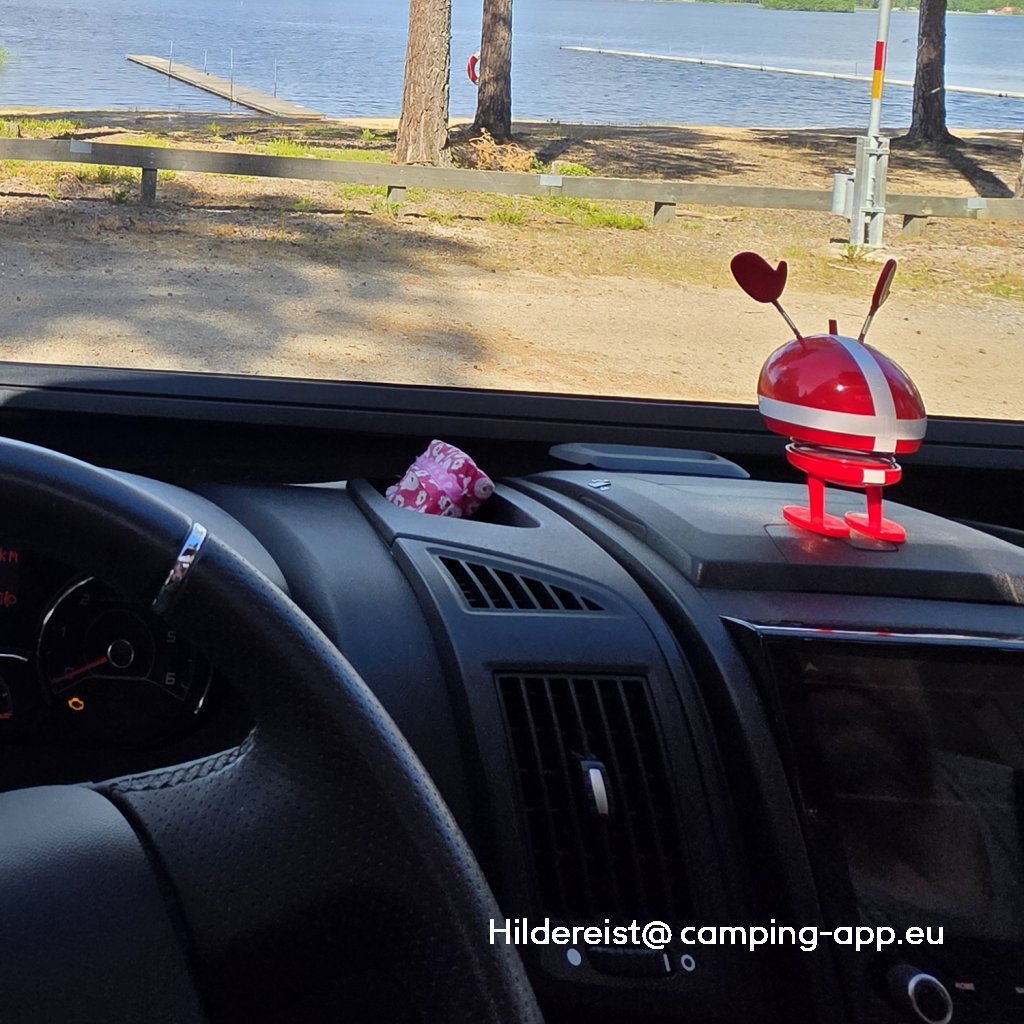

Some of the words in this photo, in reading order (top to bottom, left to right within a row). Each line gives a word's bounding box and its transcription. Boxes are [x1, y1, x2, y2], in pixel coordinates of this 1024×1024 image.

[79, 593, 90, 606] 2
[166, 630, 177, 643] 5
[165, 672, 176, 685] 6
